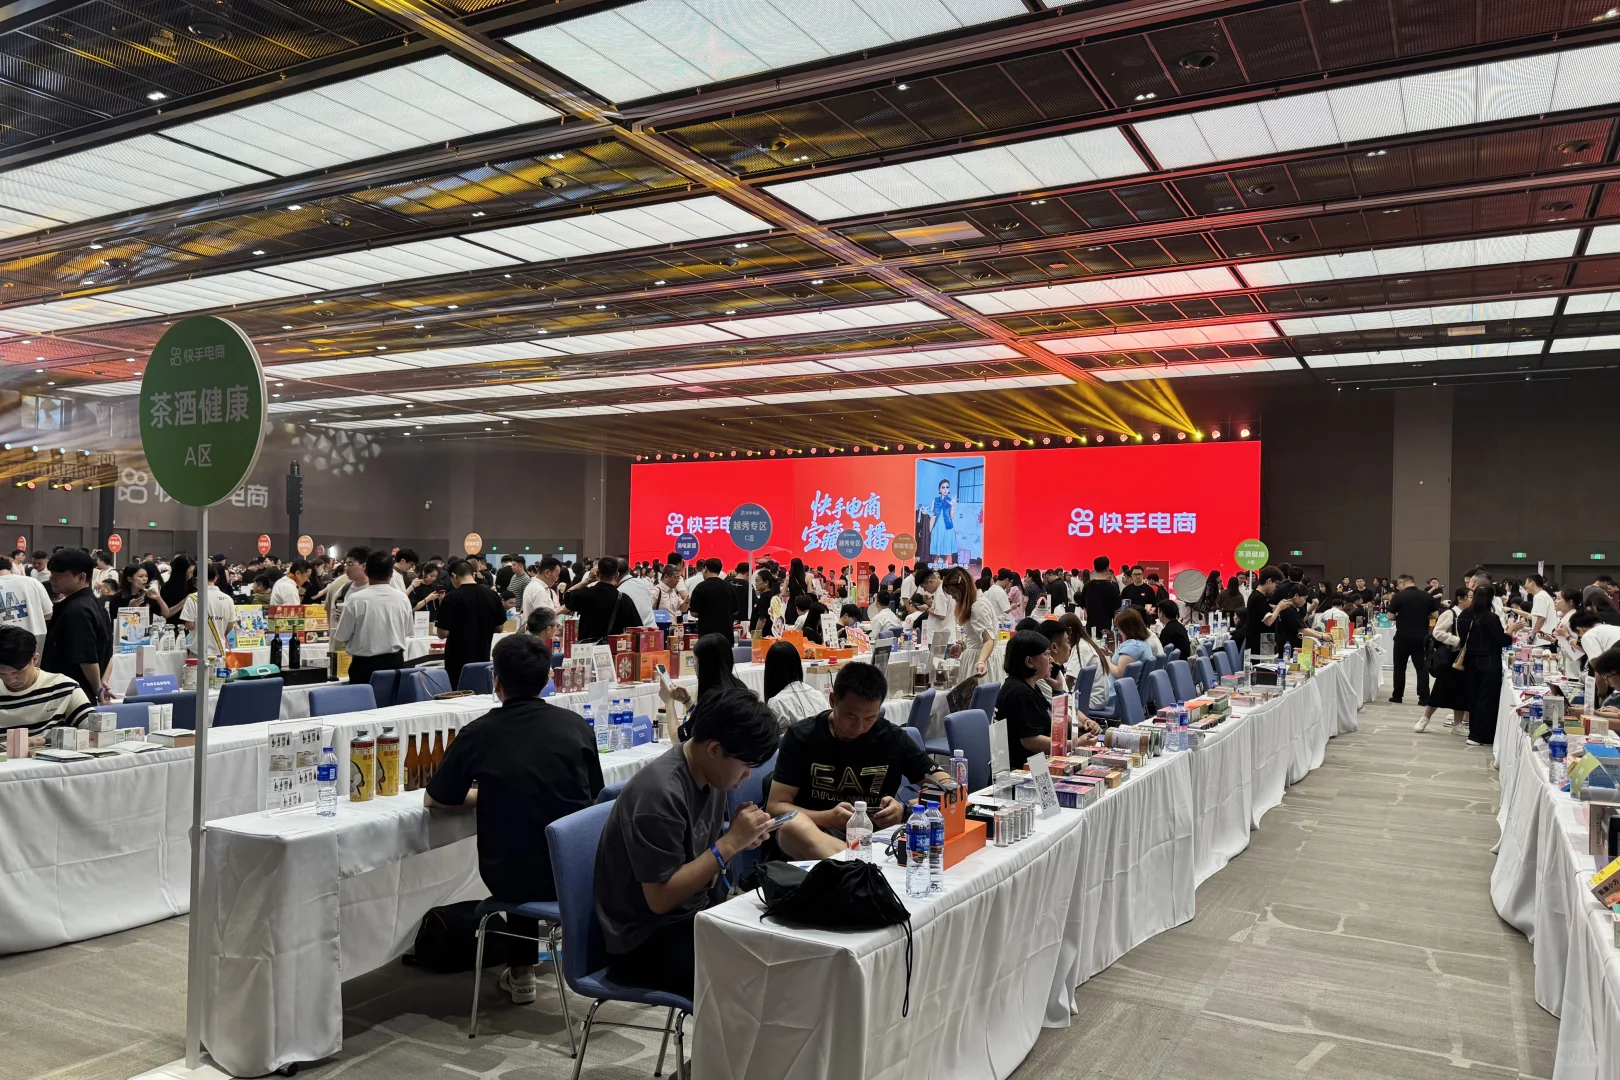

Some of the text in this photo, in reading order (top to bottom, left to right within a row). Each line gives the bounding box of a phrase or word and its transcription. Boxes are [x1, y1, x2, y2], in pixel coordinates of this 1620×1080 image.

[183, 344, 225, 363] 快手电商
[150, 385, 249, 428] 茶酒健康
[184, 444, 212, 467] A区
[810, 490, 880, 521] 快手电商
[687, 516, 731, 534] 快手电
[733, 521, 767, 531] 越秀专区
[1099, 512, 1197, 534] 快手电商
[1237, 550, 1265, 558] 茶酒健康
[810, 762, 889, 795] EA7
